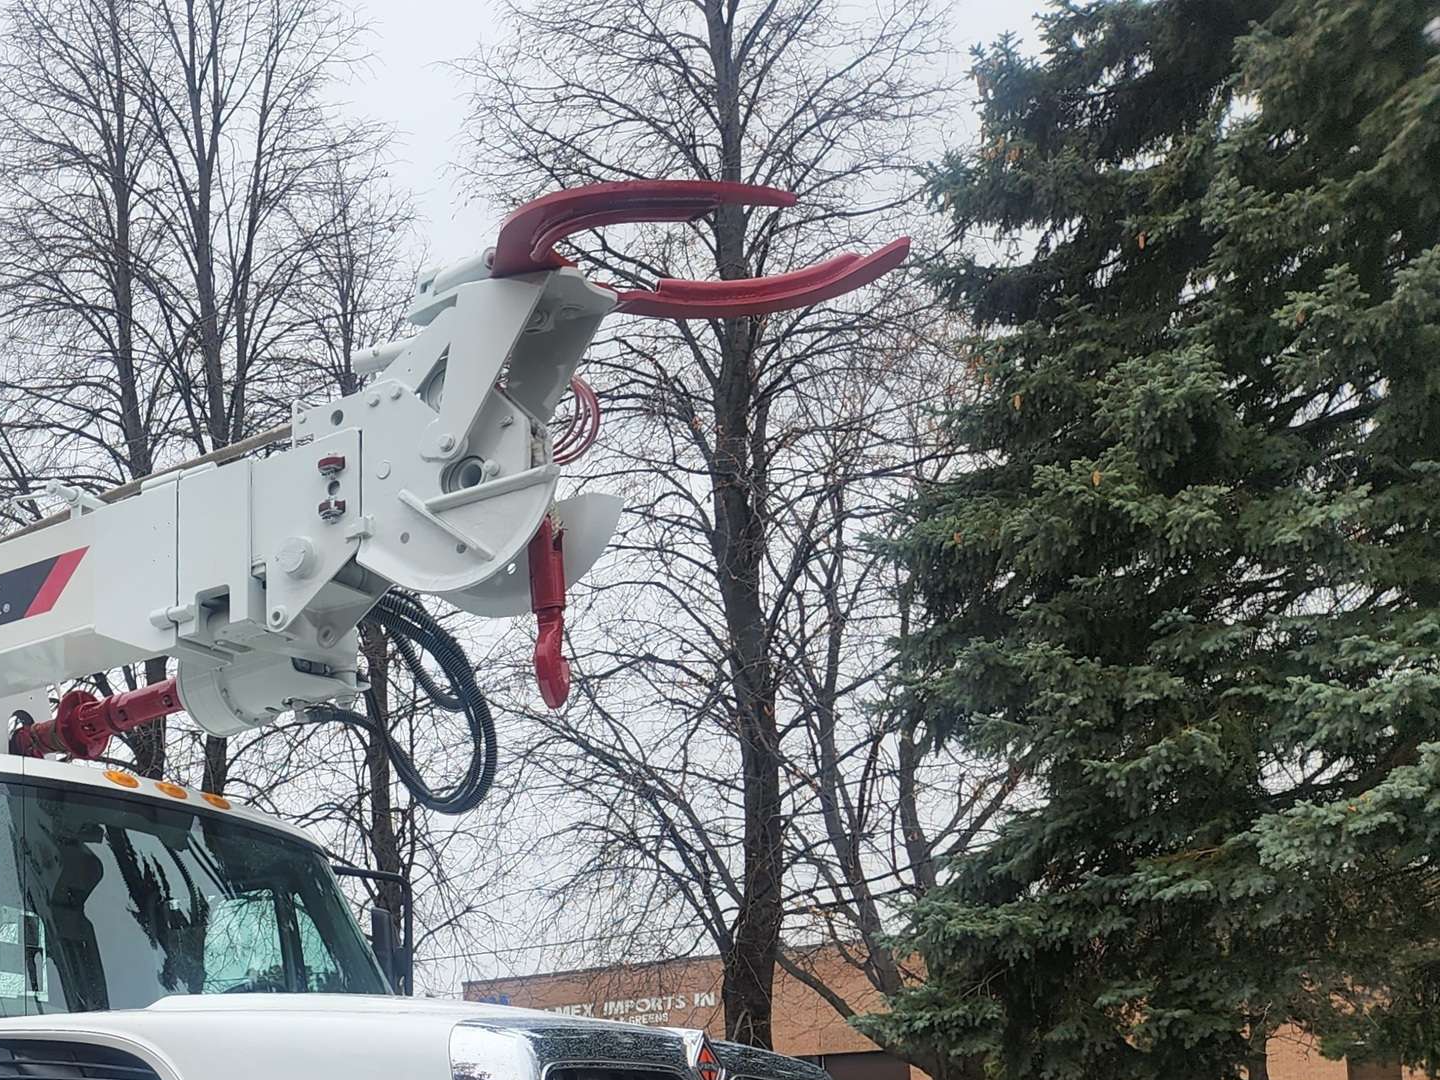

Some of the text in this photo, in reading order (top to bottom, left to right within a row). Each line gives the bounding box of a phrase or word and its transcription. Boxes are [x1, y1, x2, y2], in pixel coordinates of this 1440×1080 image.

[544, 1003, 594, 1017] MEX
[603, 994, 686, 1016] IMPORTS
[628, 1012, 669, 1025] GREENS
